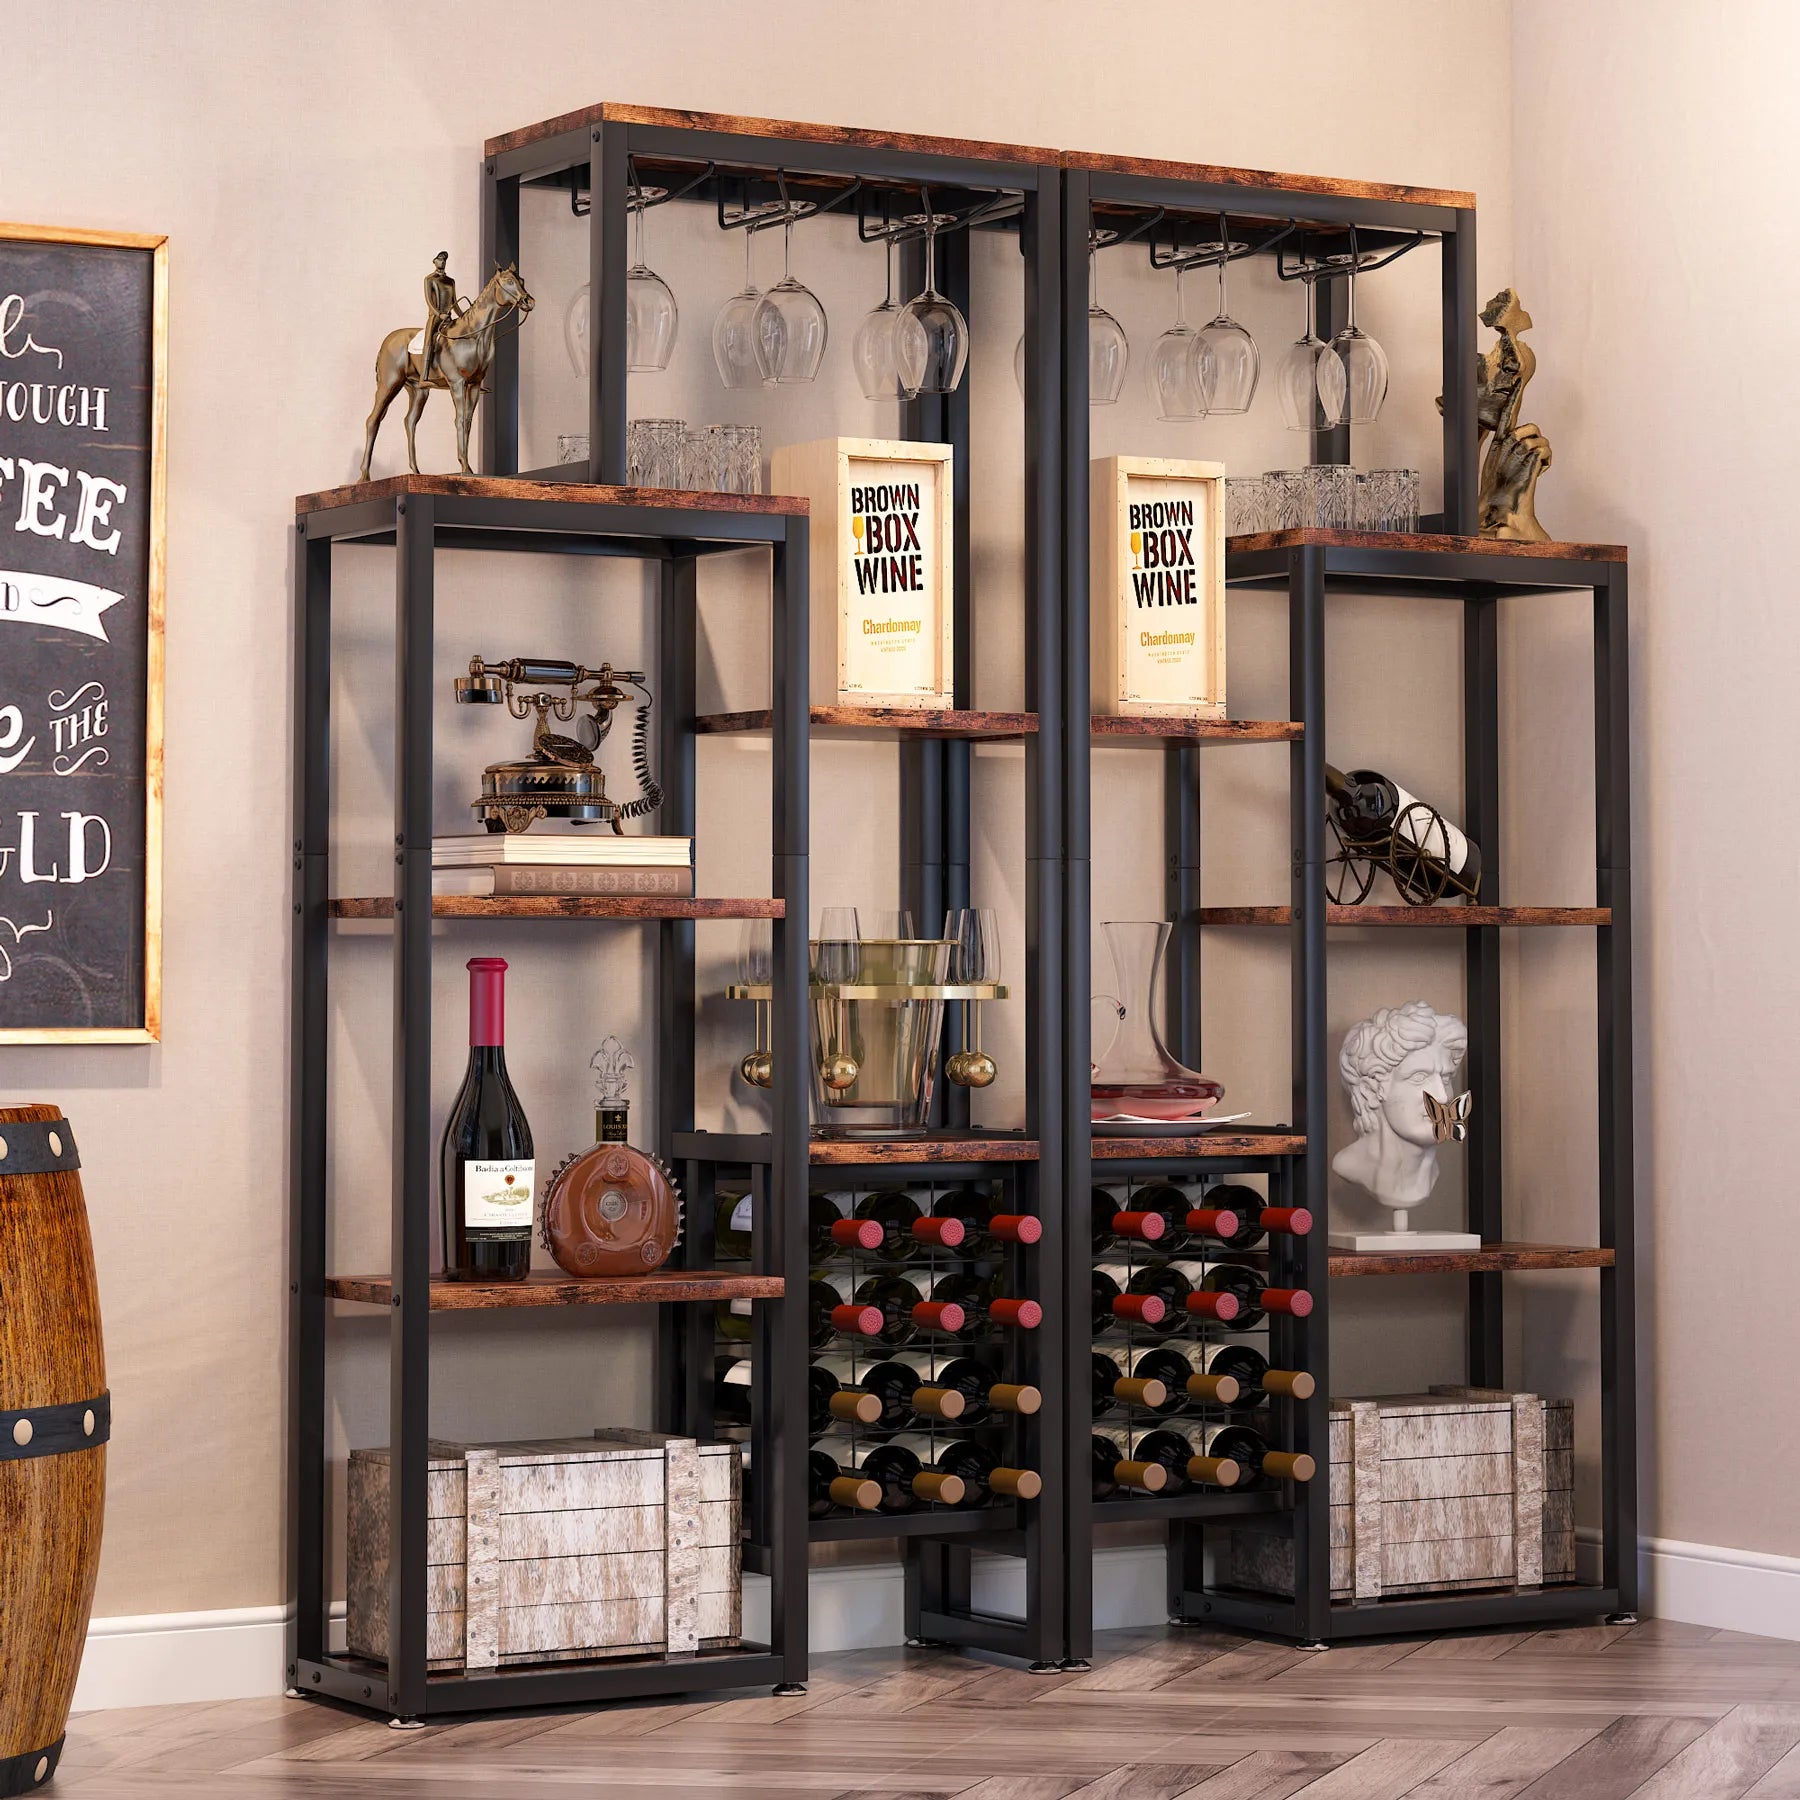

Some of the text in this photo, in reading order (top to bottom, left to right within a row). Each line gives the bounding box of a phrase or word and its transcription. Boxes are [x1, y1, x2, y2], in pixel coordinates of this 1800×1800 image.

[0, 380, 110, 431] OUGH
[851, 483, 920, 514] BROWN
[1129, 500, 1194, 530] BROWN
[865, 512, 921, 555] BOX
[1142, 528, 1195, 569] BOX
[854, 554, 924, 595] WINE
[1132, 568, 1198, 609] WINE
[862, 617, 922, 635] Chardonnay
[1140, 630, 1196, 647] Chardonnay
[49, 700, 109, 753] THE
